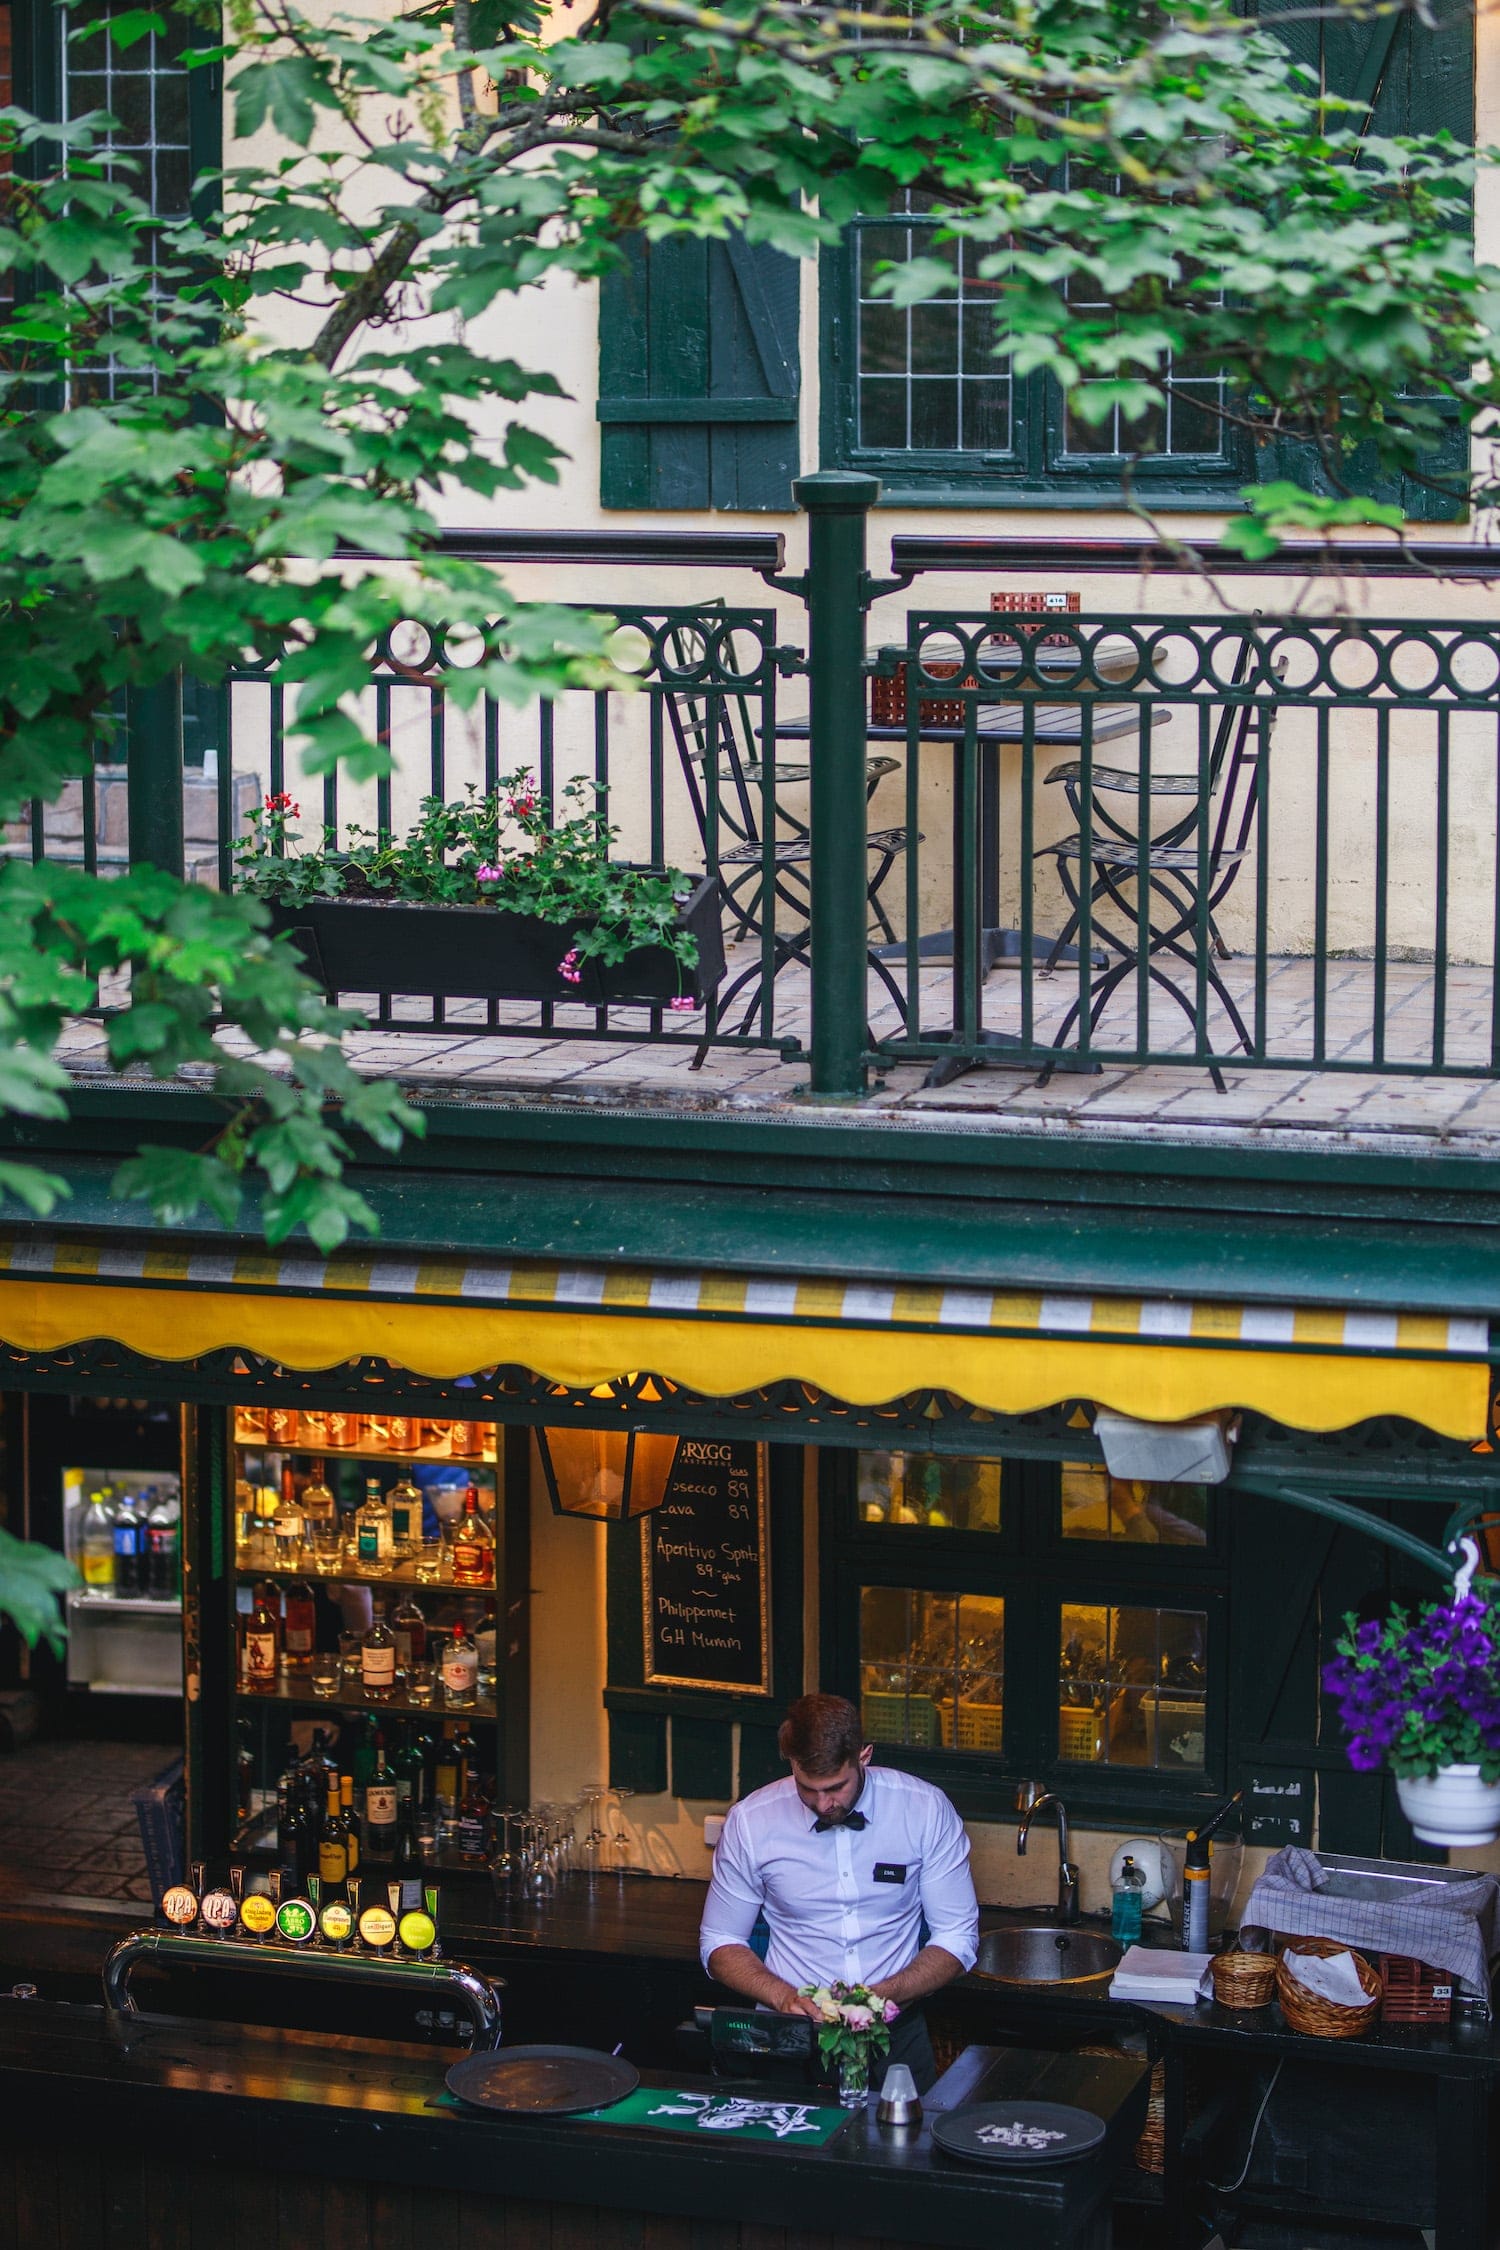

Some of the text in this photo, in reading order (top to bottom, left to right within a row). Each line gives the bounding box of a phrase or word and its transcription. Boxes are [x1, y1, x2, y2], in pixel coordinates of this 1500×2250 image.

[673, 1480, 749, 1499] osecco 89
[728, 1504, 749, 1520] 89
[657, 1536, 716, 1562] Aperitivo
[692, 1631, 742, 1650] Mumm
[167, 1895, 193, 1914] APA
[206, 1898, 230, 1919] IPA
